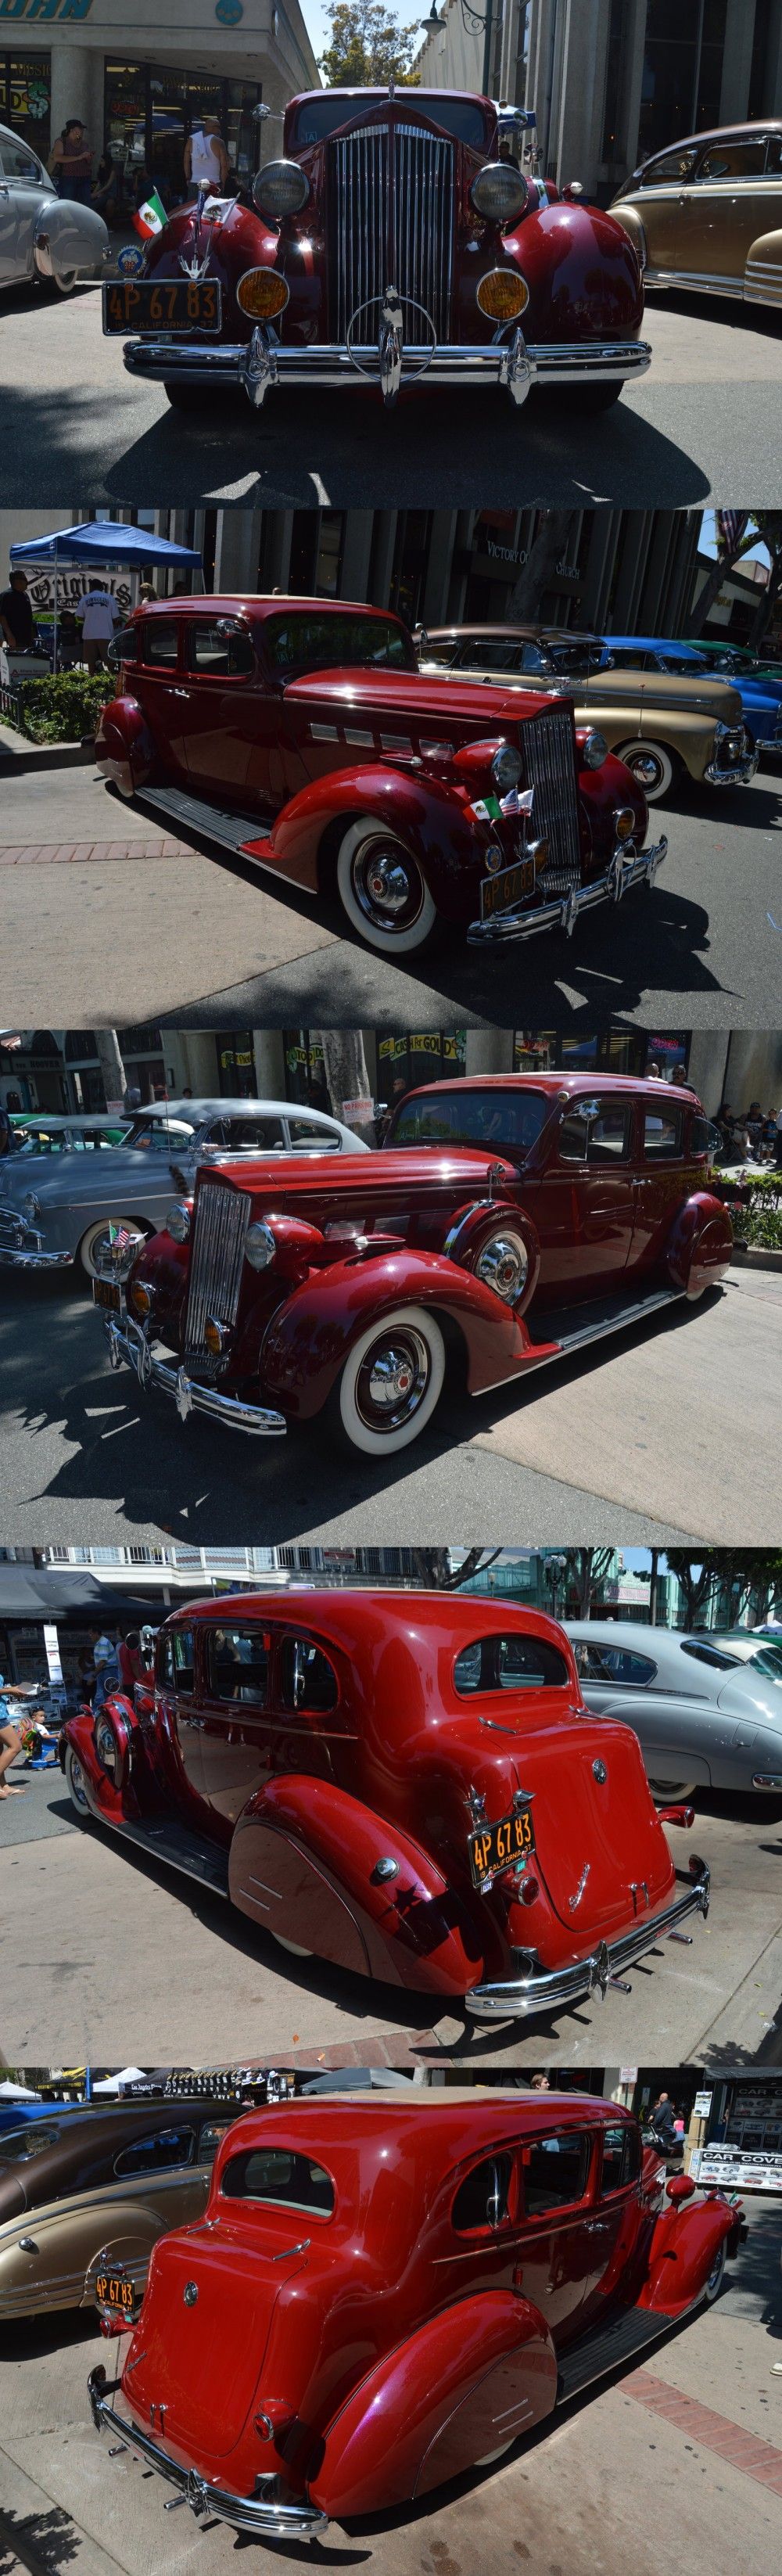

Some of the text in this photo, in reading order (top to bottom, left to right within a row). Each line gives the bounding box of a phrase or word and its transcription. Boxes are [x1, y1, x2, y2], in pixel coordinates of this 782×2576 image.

[109, 283, 216, 320] 4P 67 83
[131, 321, 192, 329] CALIFORNIA
[487, 541, 518, 563] VICTORY
[556, 562, 580, 579] CHURCH
[424, 1036, 451, 1056] GOLD
[474, 1813, 531, 1870] 4P 67 83
[488, 1849, 522, 1872] CALIFORNIA
[703, 2152, 734, 2161] CAR
[96, 2277, 132, 2306] 4P 67 83
